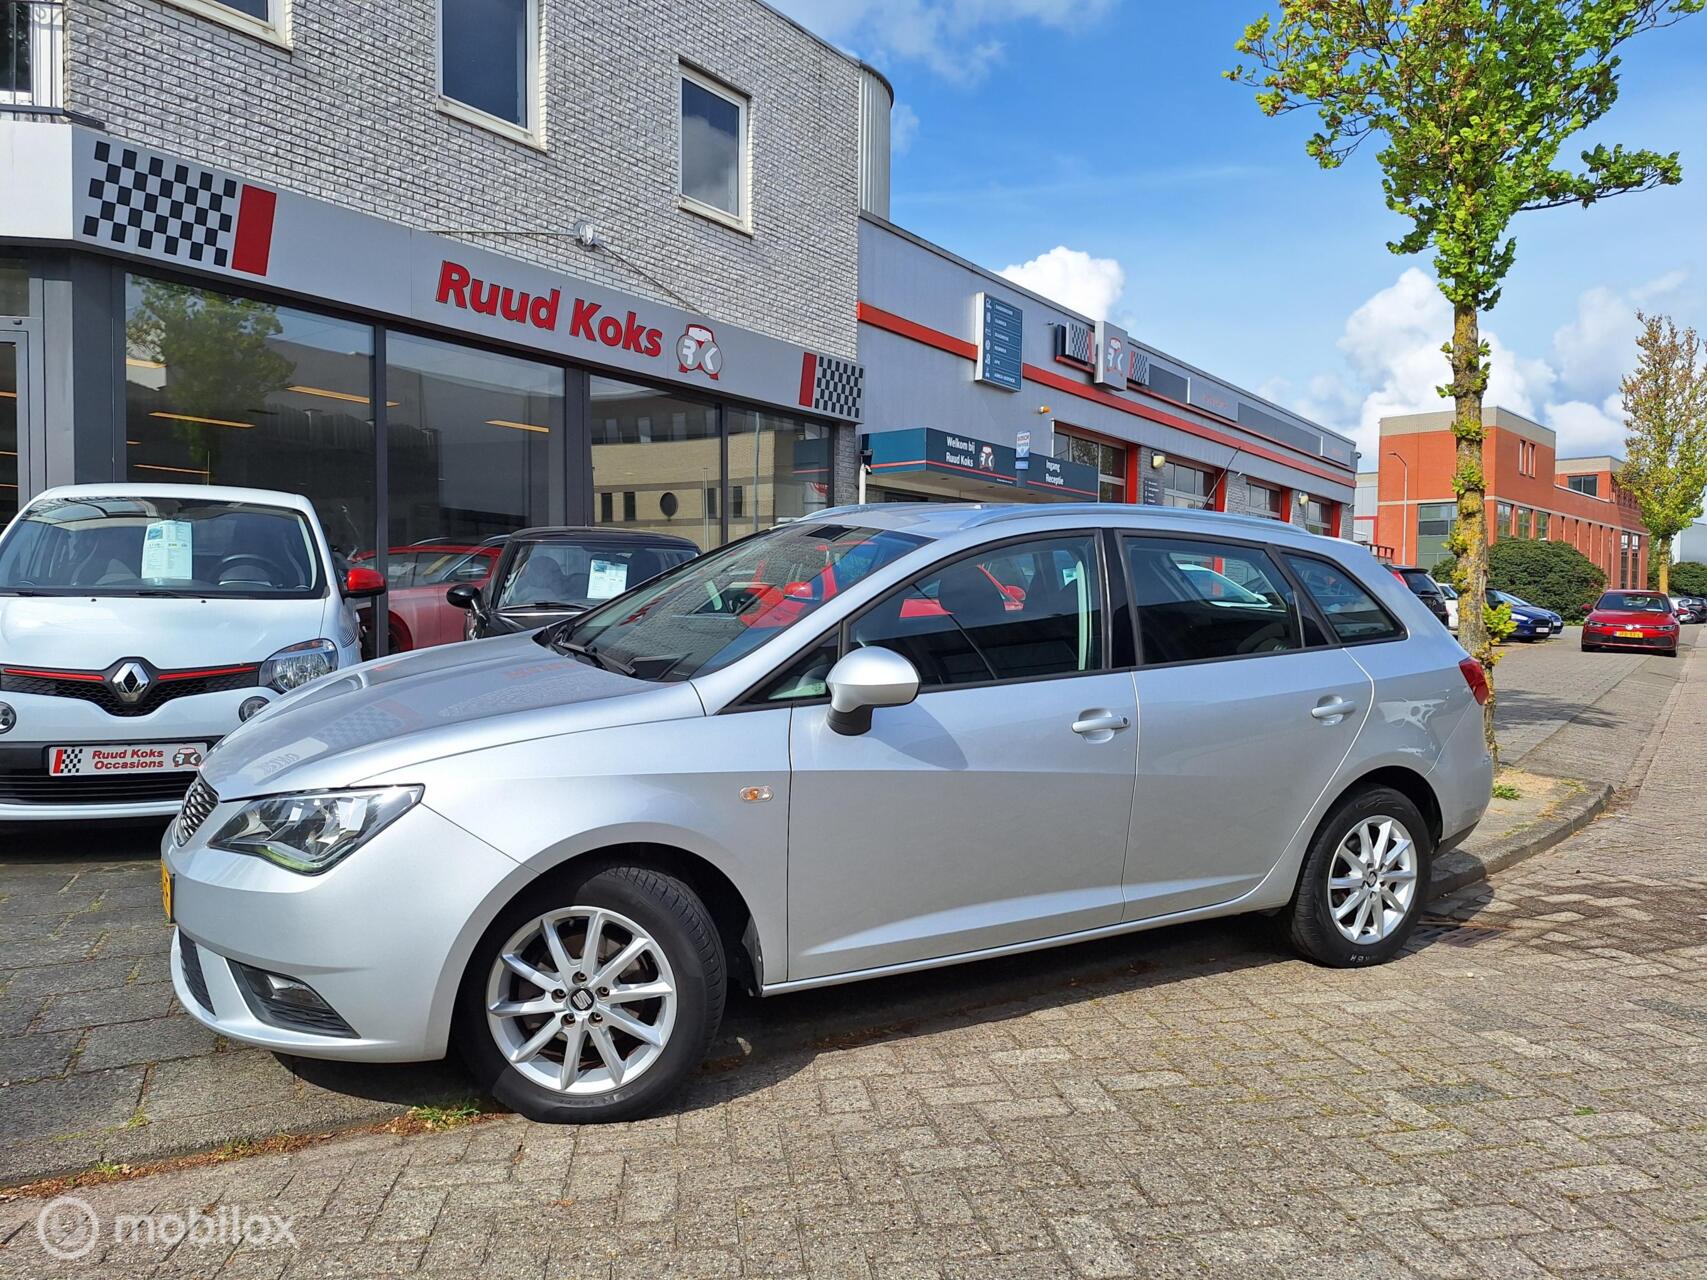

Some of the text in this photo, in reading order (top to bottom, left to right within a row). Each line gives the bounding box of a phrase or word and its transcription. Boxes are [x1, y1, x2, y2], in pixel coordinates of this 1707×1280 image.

[435, 259, 663, 357] Ruud Koks
[946, 436, 976, 454] Welkom bij
[945, 452, 974, 467] Ruud Koks
[1045, 473, 1064, 486] Receptie
[92, 749, 164, 760] Ruud Koks
[93, 759, 164, 770] Occasions
